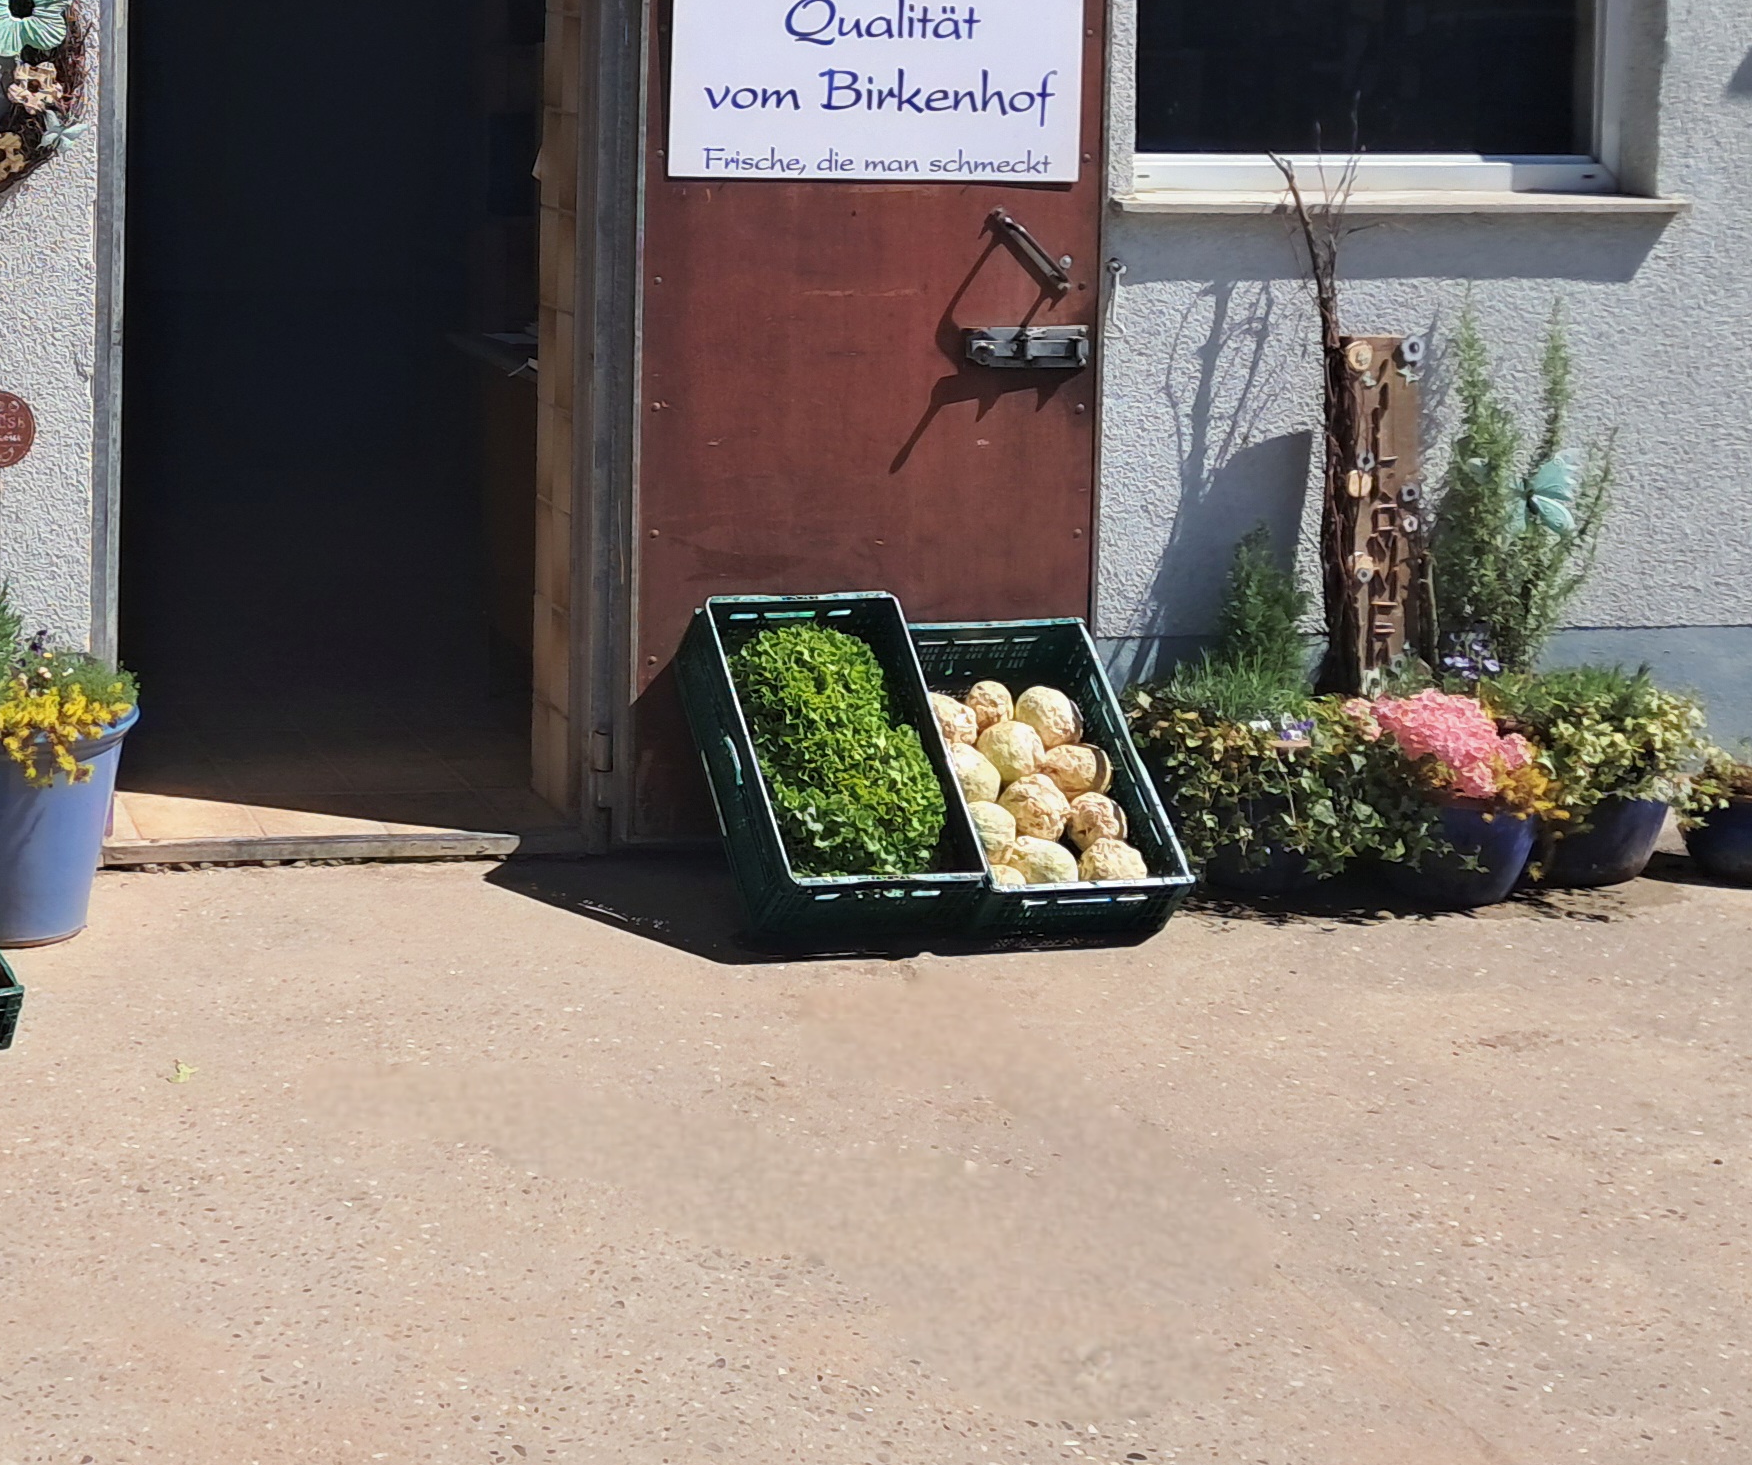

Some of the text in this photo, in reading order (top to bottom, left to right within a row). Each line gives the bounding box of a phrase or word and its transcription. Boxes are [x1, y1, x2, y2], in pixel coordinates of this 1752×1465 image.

[703, 67, 1059, 128] vom Birkenhof
[702, 146, 1053, 176] Frische, die man schmeckt
